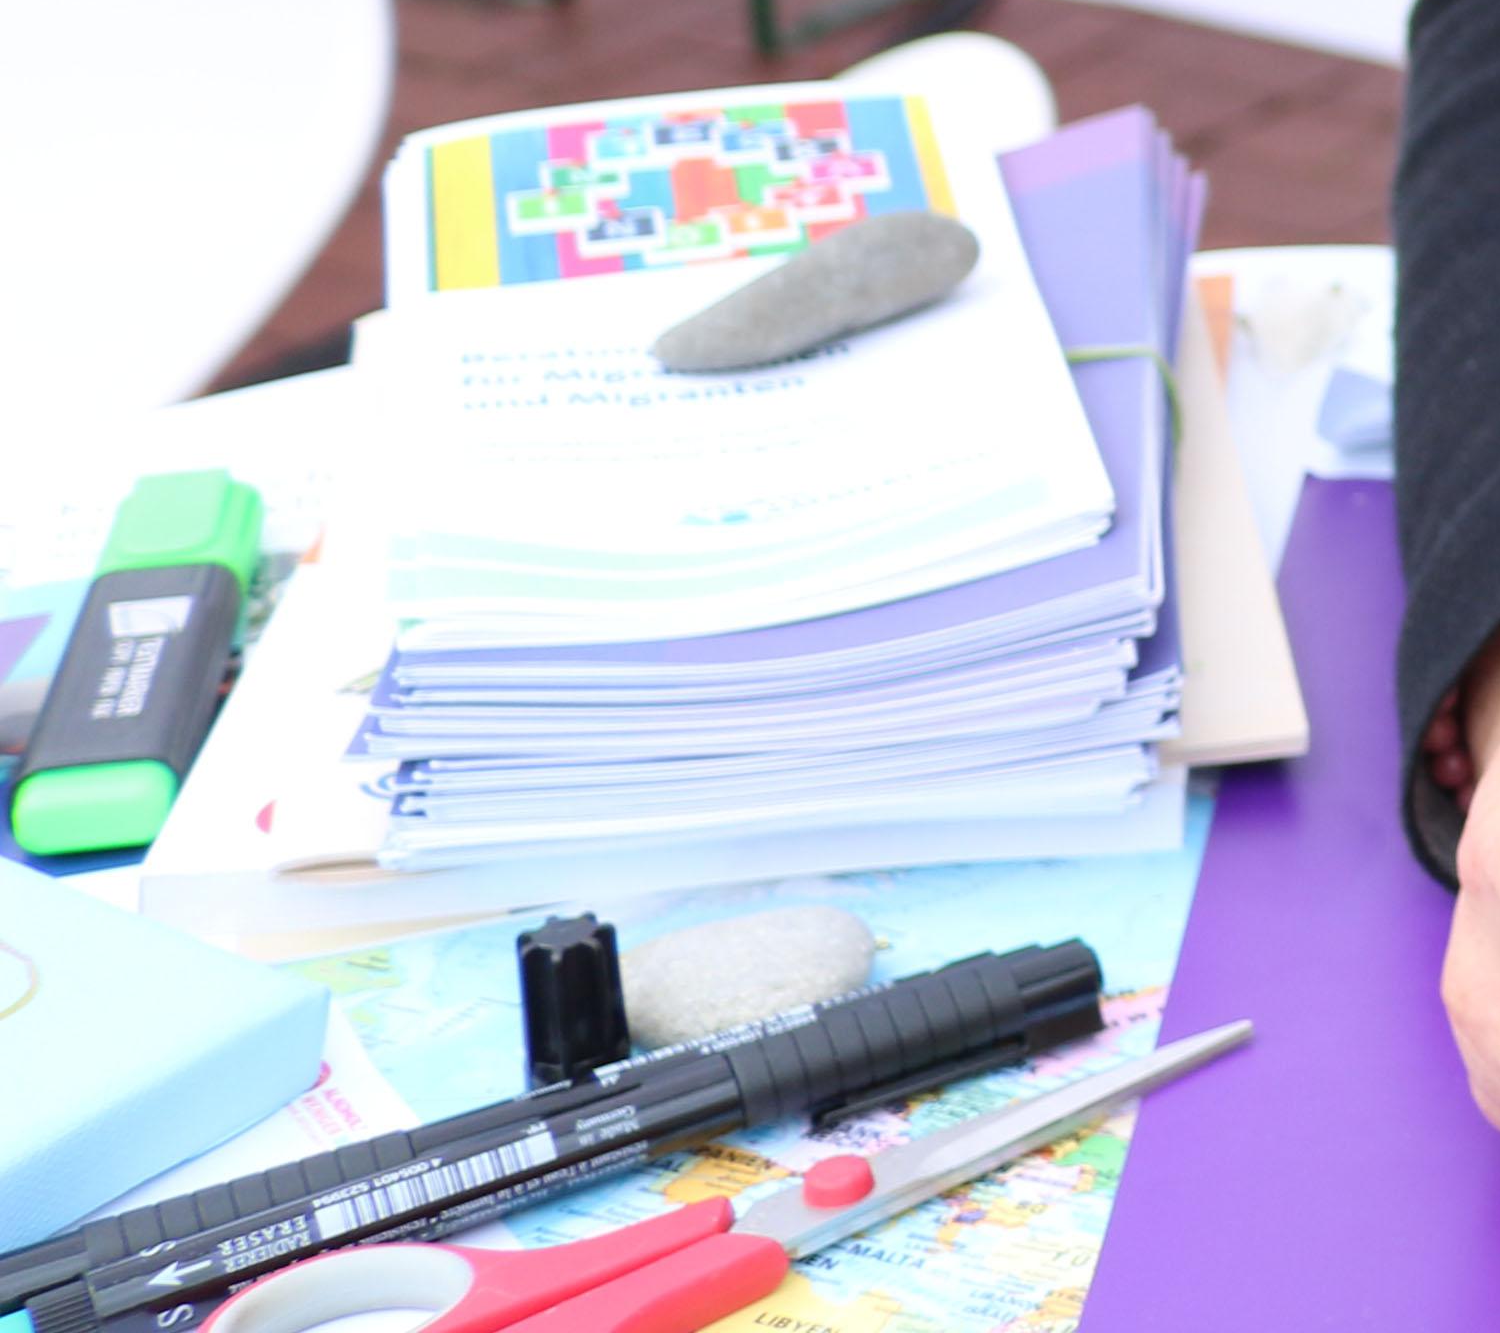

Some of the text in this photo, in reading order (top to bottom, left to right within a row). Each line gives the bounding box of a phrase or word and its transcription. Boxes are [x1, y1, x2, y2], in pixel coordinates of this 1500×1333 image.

[568, 375, 806, 410] Migranten
[310, 1155, 443, 1208] 4 005401 523994
[216, 1214, 309, 1257] ERASER
[221, 1229, 314, 1273] RADIERER
[156, 1303, 195, 1328] S
